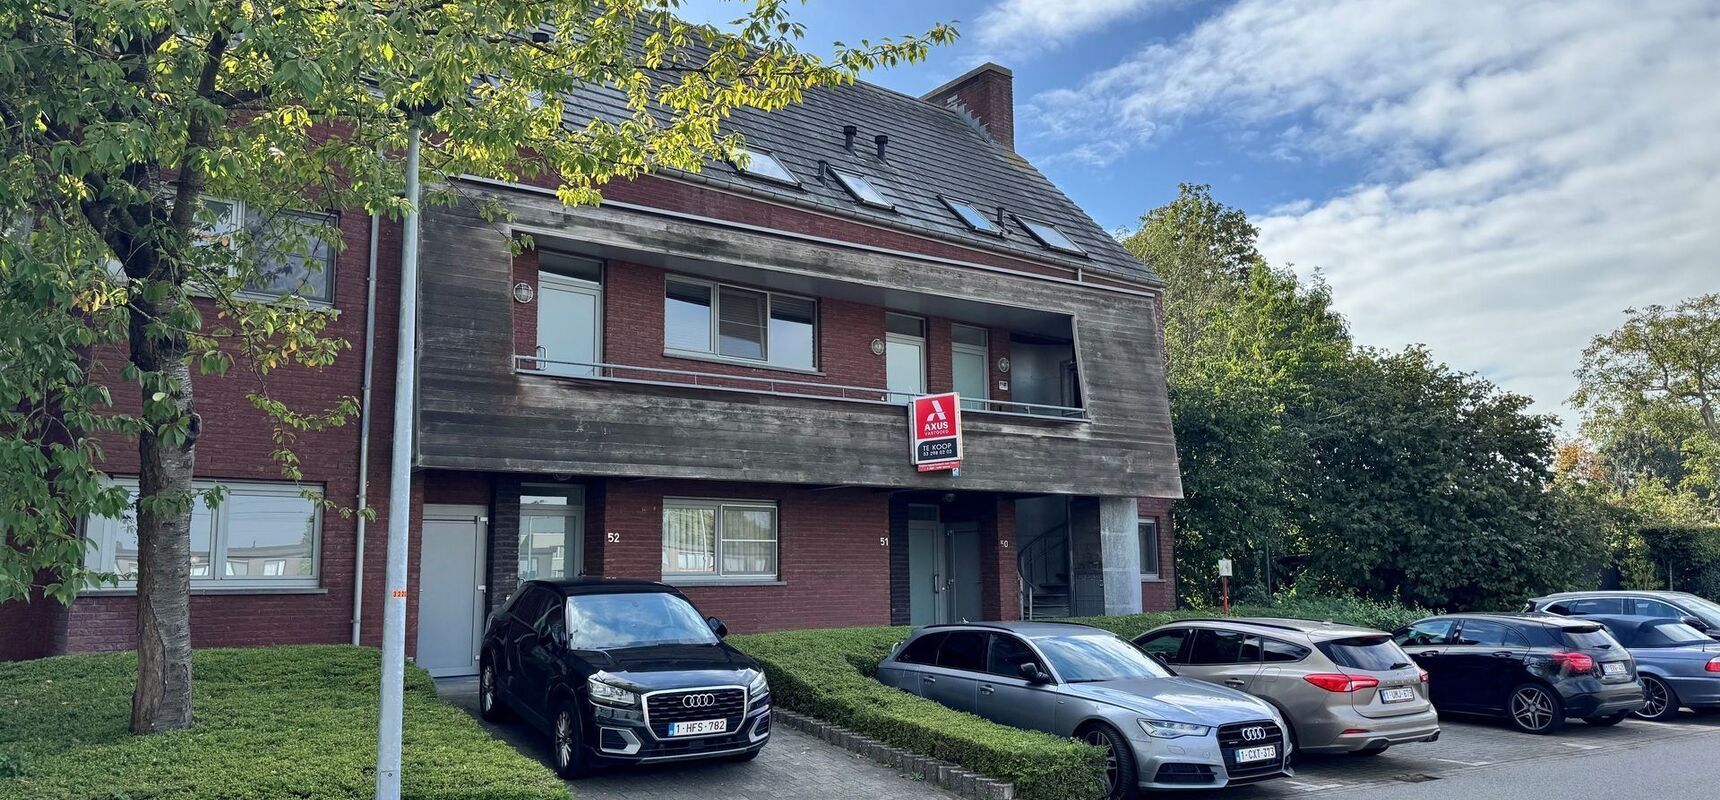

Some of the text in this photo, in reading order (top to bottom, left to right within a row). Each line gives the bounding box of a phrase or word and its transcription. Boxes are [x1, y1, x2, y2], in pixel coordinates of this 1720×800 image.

[924, 422, 949, 431] AXUS
[607, 532, 620, 543] 52
[880, 537, 889, 546] 51
[1000, 540, 1009, 548] 50
[676, 720, 725, 734] 1-HFS-782
[1241, 747, 1275, 760] 1-CXT-373
